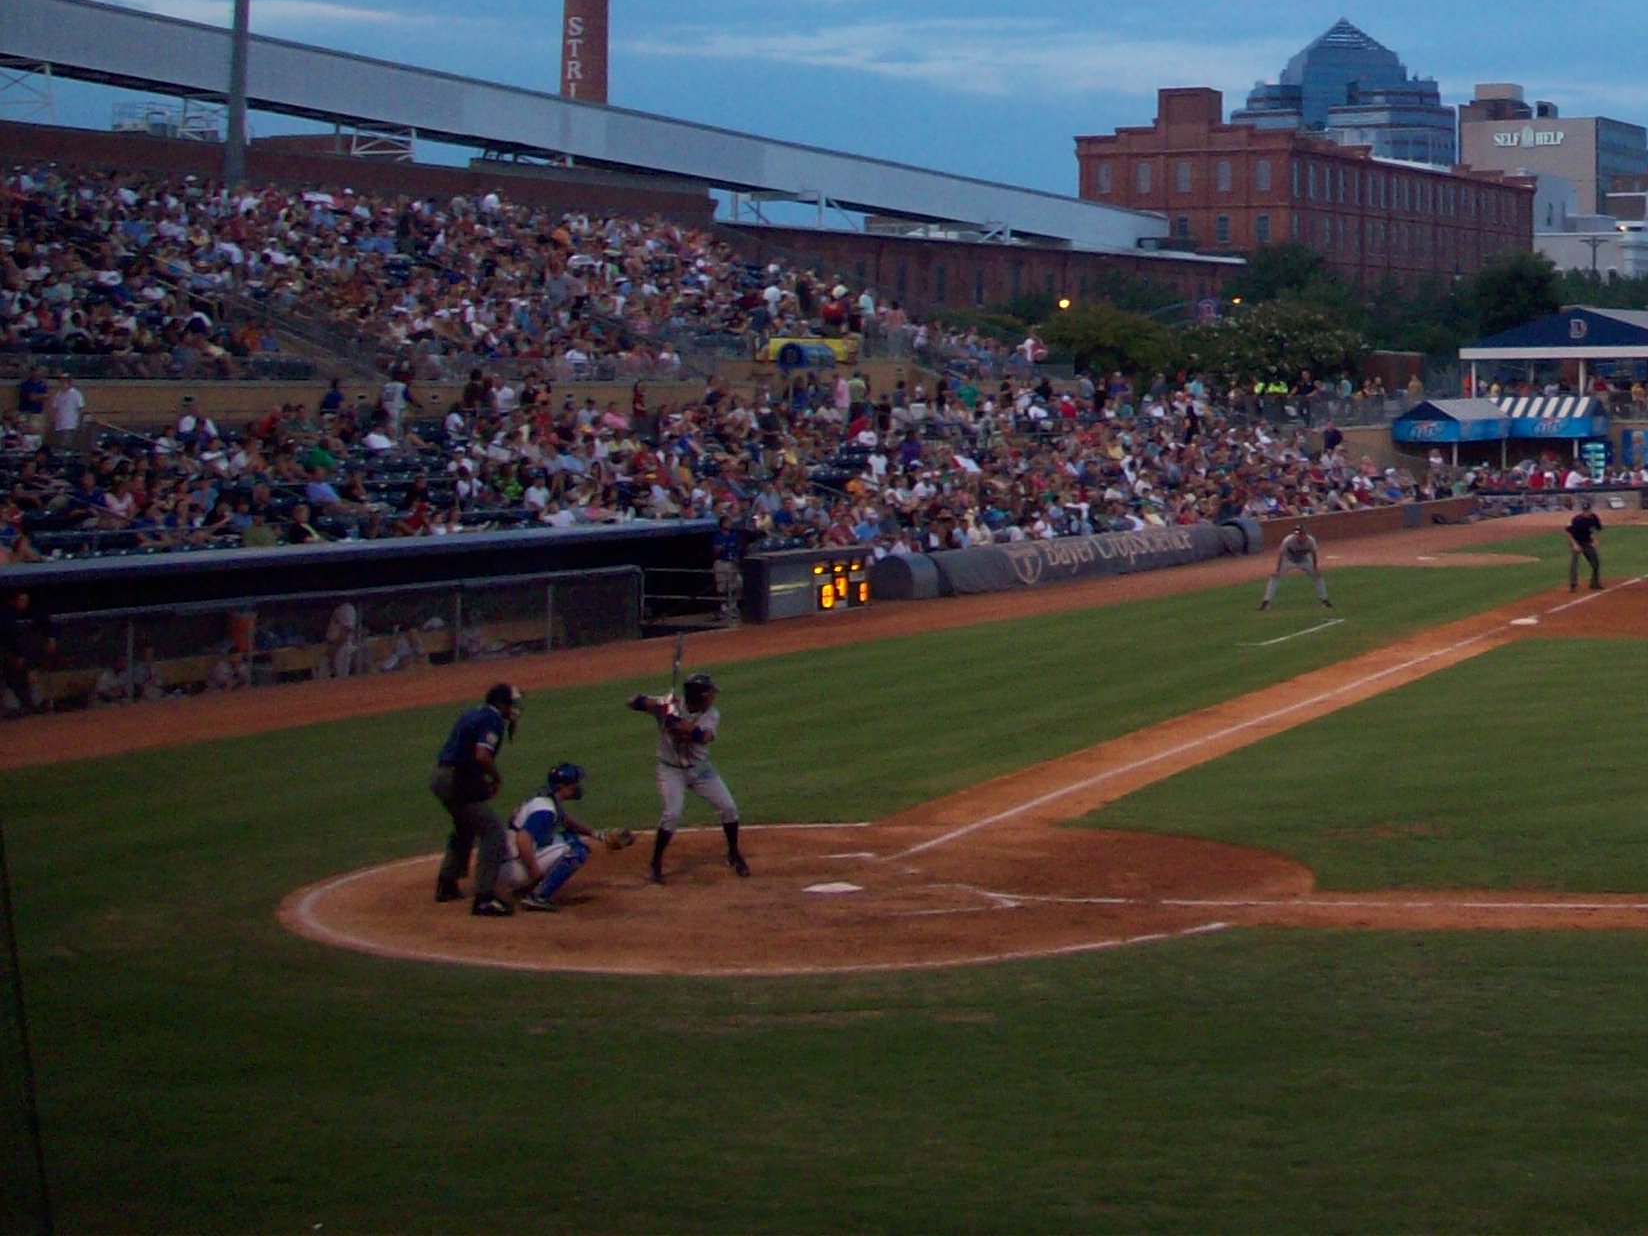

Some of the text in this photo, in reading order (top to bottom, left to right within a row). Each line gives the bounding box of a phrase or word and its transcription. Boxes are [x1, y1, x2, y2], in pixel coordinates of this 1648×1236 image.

[1493, 131, 1565, 147] SELF HELP
[1046, 540, 1096, 575] Bayer
